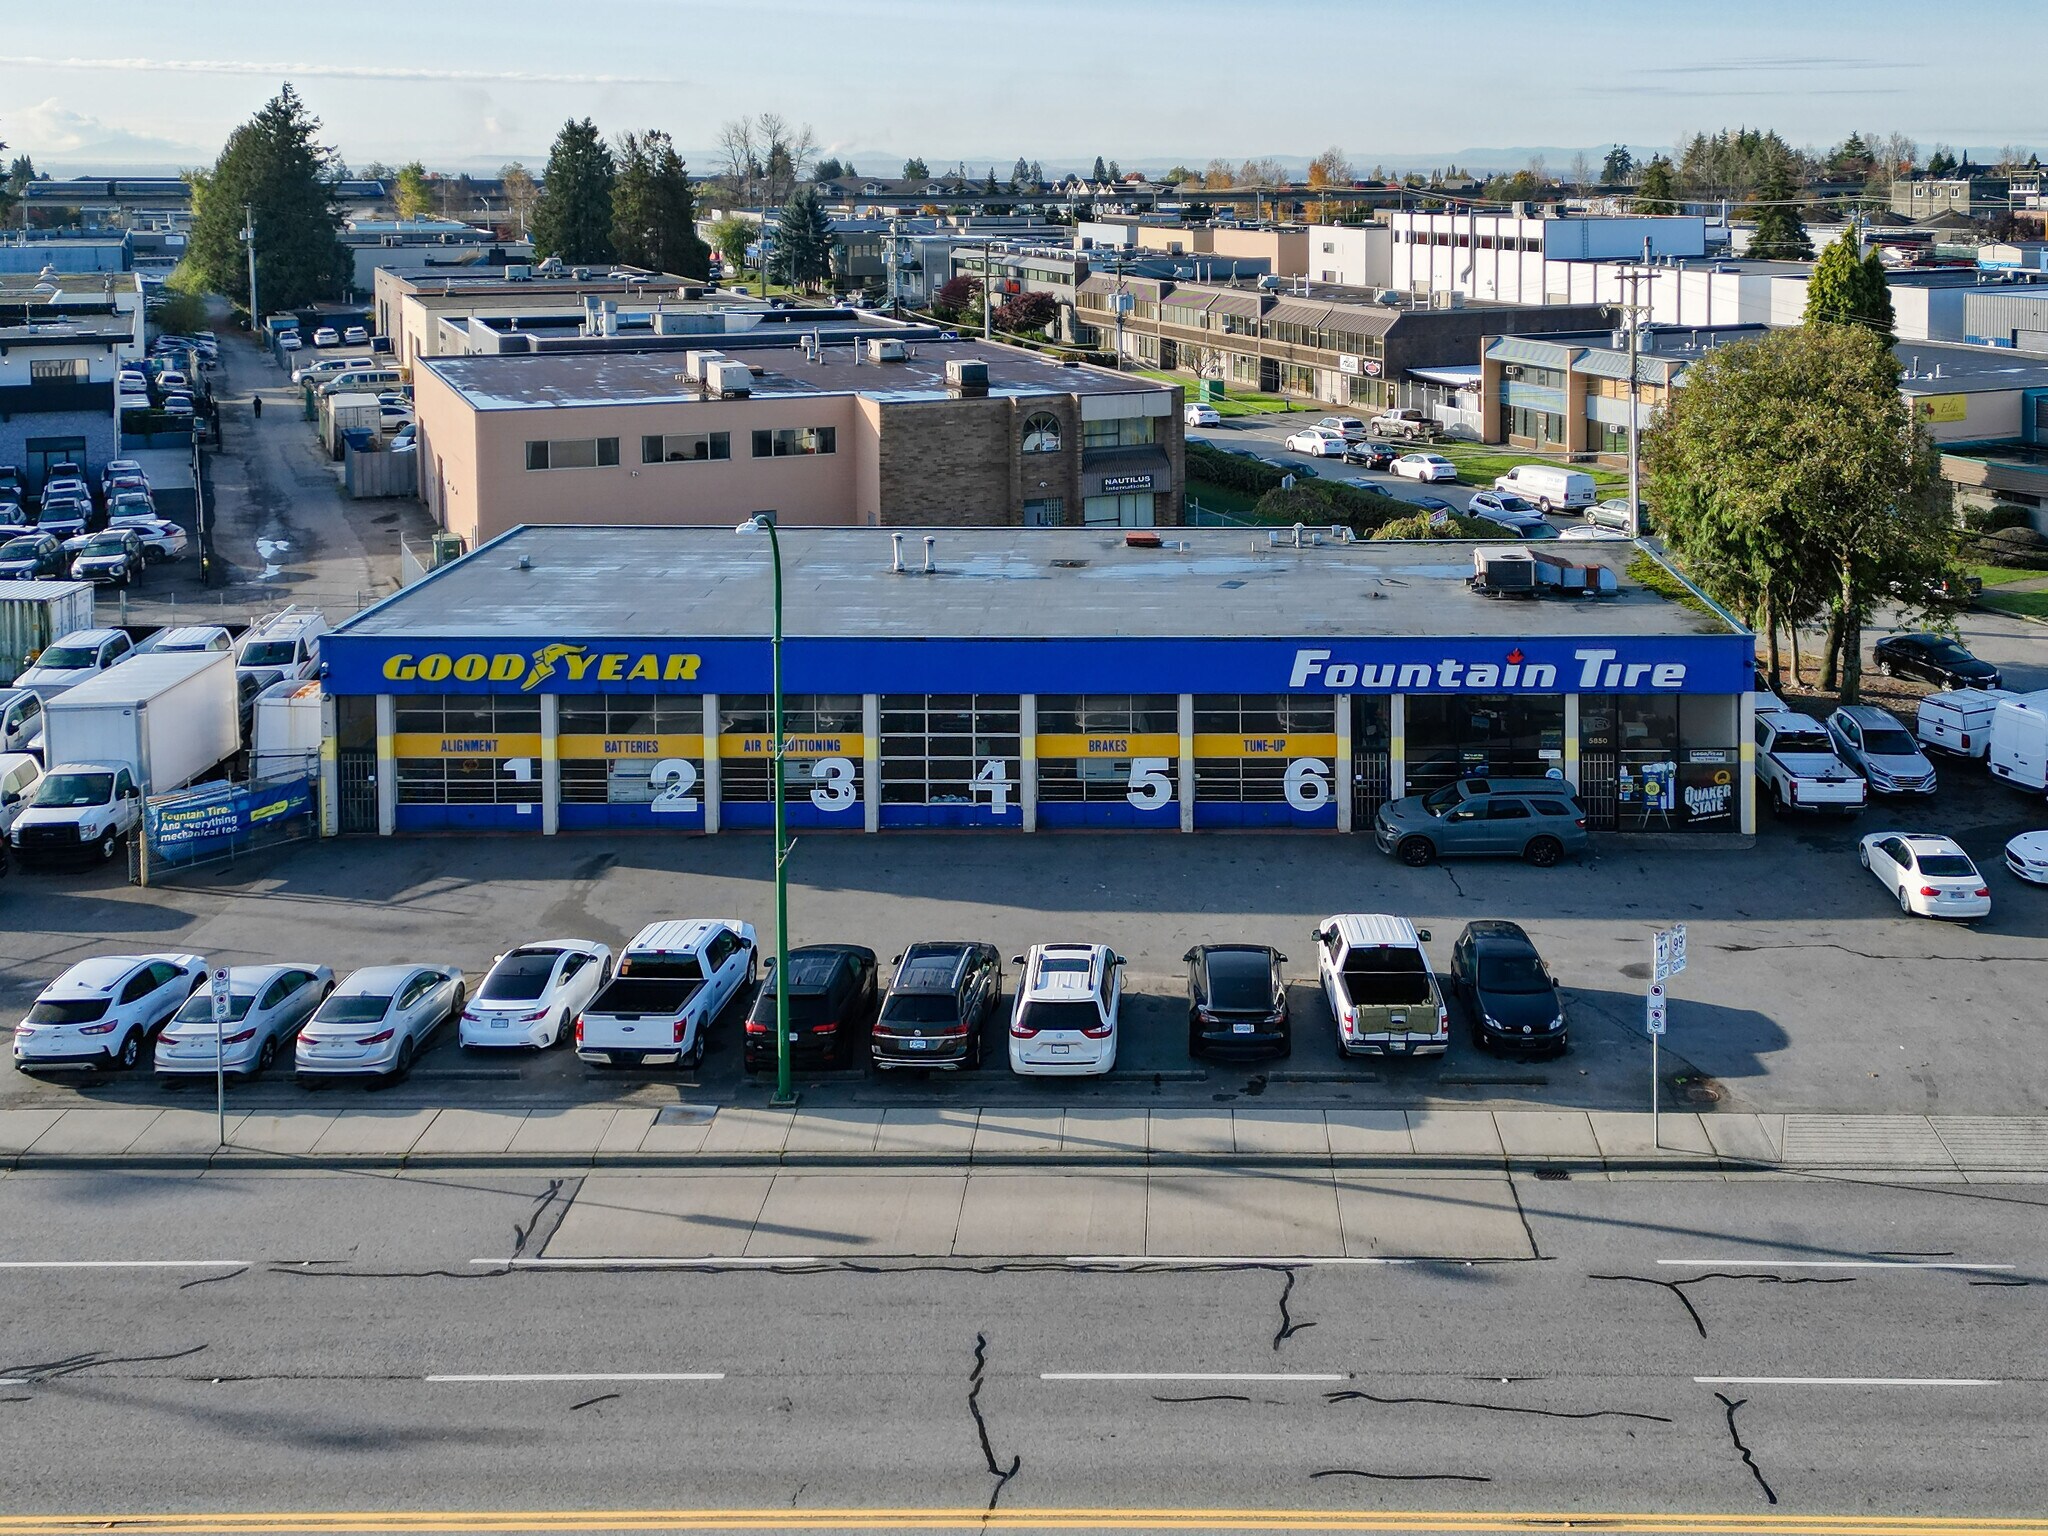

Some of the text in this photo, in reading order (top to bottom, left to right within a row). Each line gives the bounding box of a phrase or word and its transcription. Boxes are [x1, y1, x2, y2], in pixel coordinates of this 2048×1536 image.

[1105, 476, 1151, 485] NAUTILUS
[1289, 649, 1686, 688] Fountain Tire
[441, 739, 499, 752] ALIGNMENT
[604, 740, 659, 753] BATTERIES
[744, 739, 761, 752] AIR
[1088, 739, 1127, 752] BRAKES
[1243, 739, 1286, 752] TUNE-UP
[503, 758, 532, 814] 1
[650, 758, 697, 812] 2
[810, 757, 857, 811] 3
[968, 759, 1012, 814] 4
[1126, 757, 1172, 810] 5
[1283, 757, 1330, 812] 6
[1685, 784, 1731, 807] QUAKER
[161, 810, 205, 821] Fountain
[160, 828, 219, 842] mechanical
